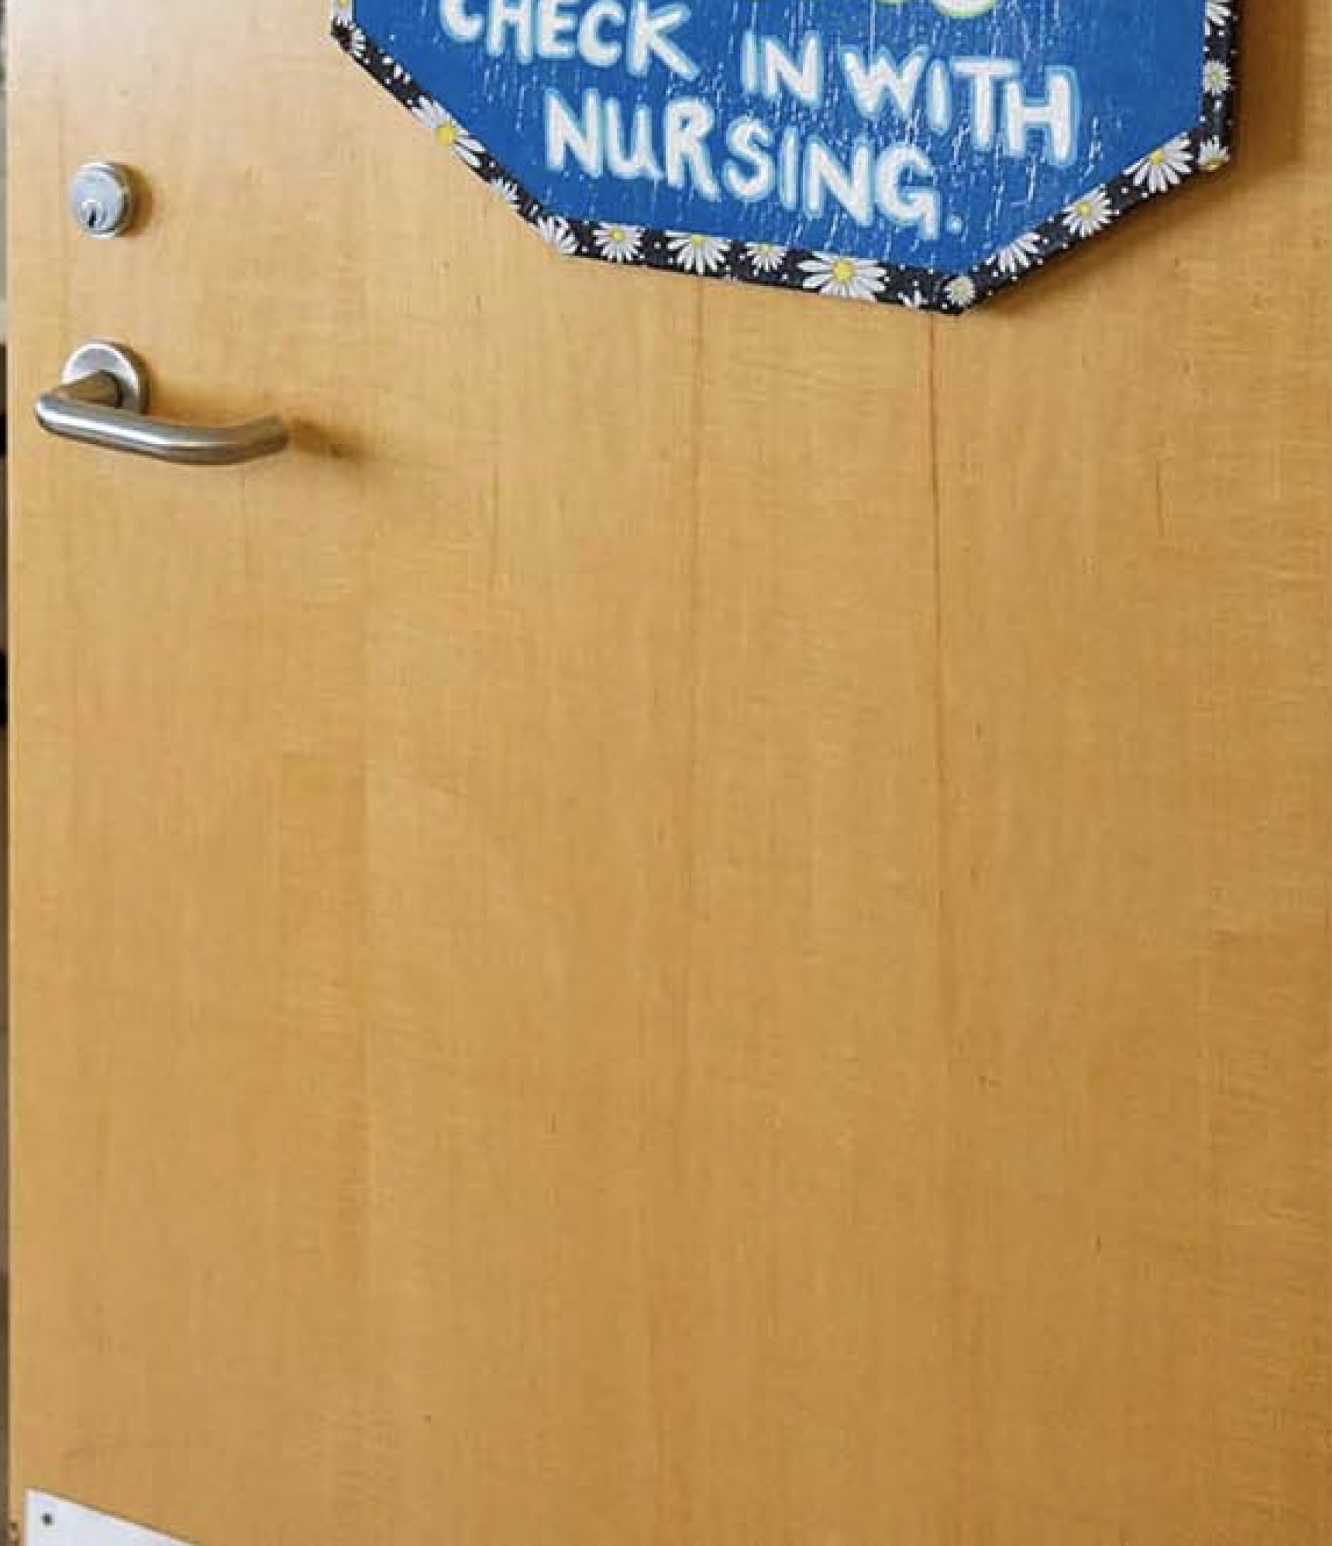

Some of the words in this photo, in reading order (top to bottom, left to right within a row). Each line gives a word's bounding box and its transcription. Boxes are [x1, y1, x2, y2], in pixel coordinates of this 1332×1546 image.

[543, 88, 967, 242] NURSING.
[740, 29, 822, 107] IN
[841, 48, 1075, 166] WITH
